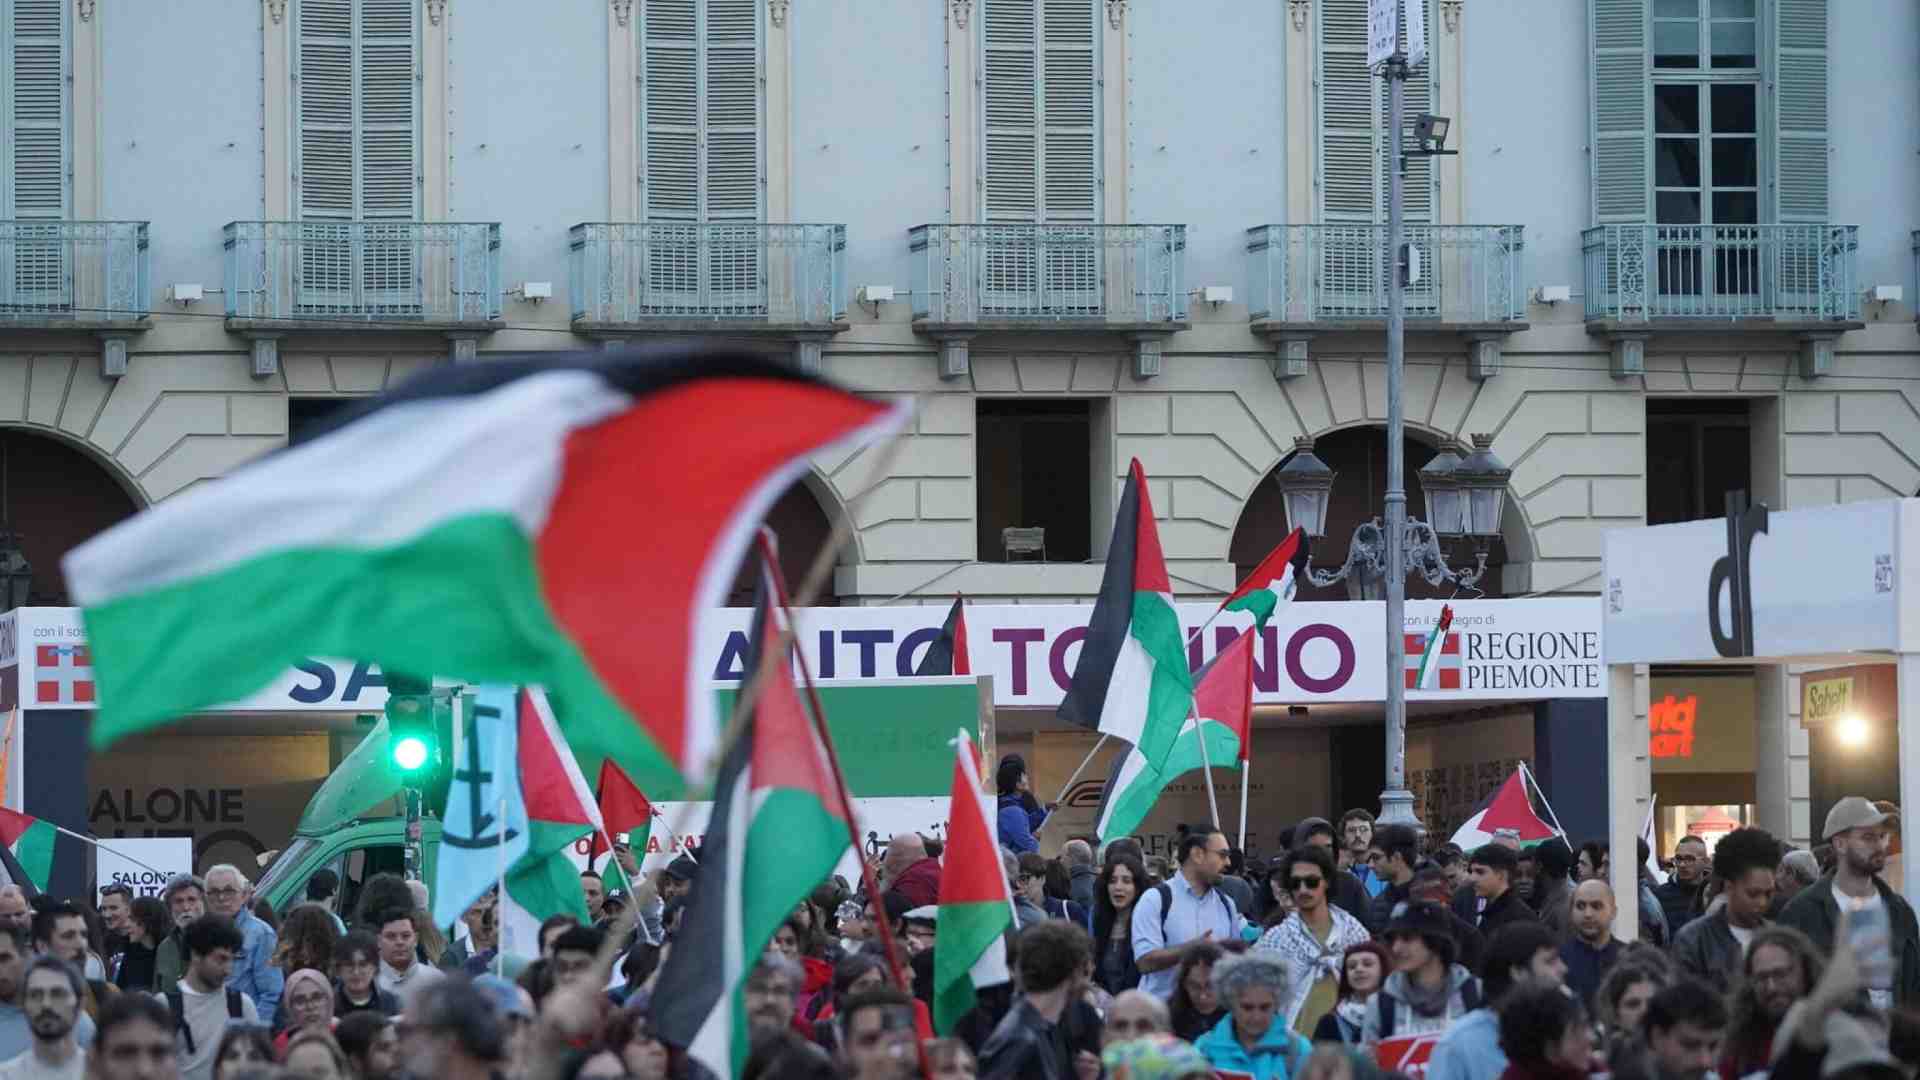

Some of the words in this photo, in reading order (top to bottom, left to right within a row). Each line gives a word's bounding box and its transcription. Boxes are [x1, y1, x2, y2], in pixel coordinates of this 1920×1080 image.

[33, 627, 55, 638] con
[57, 625, 64, 638] il
[1432, 615, 1482, 628] segno
[992, 623, 1356, 695] TOINO
[1467, 631, 1599, 661] REGIONE
[1467, 664, 1600, 689] PIEMONTE
[88, 788, 244, 823] ALONE
